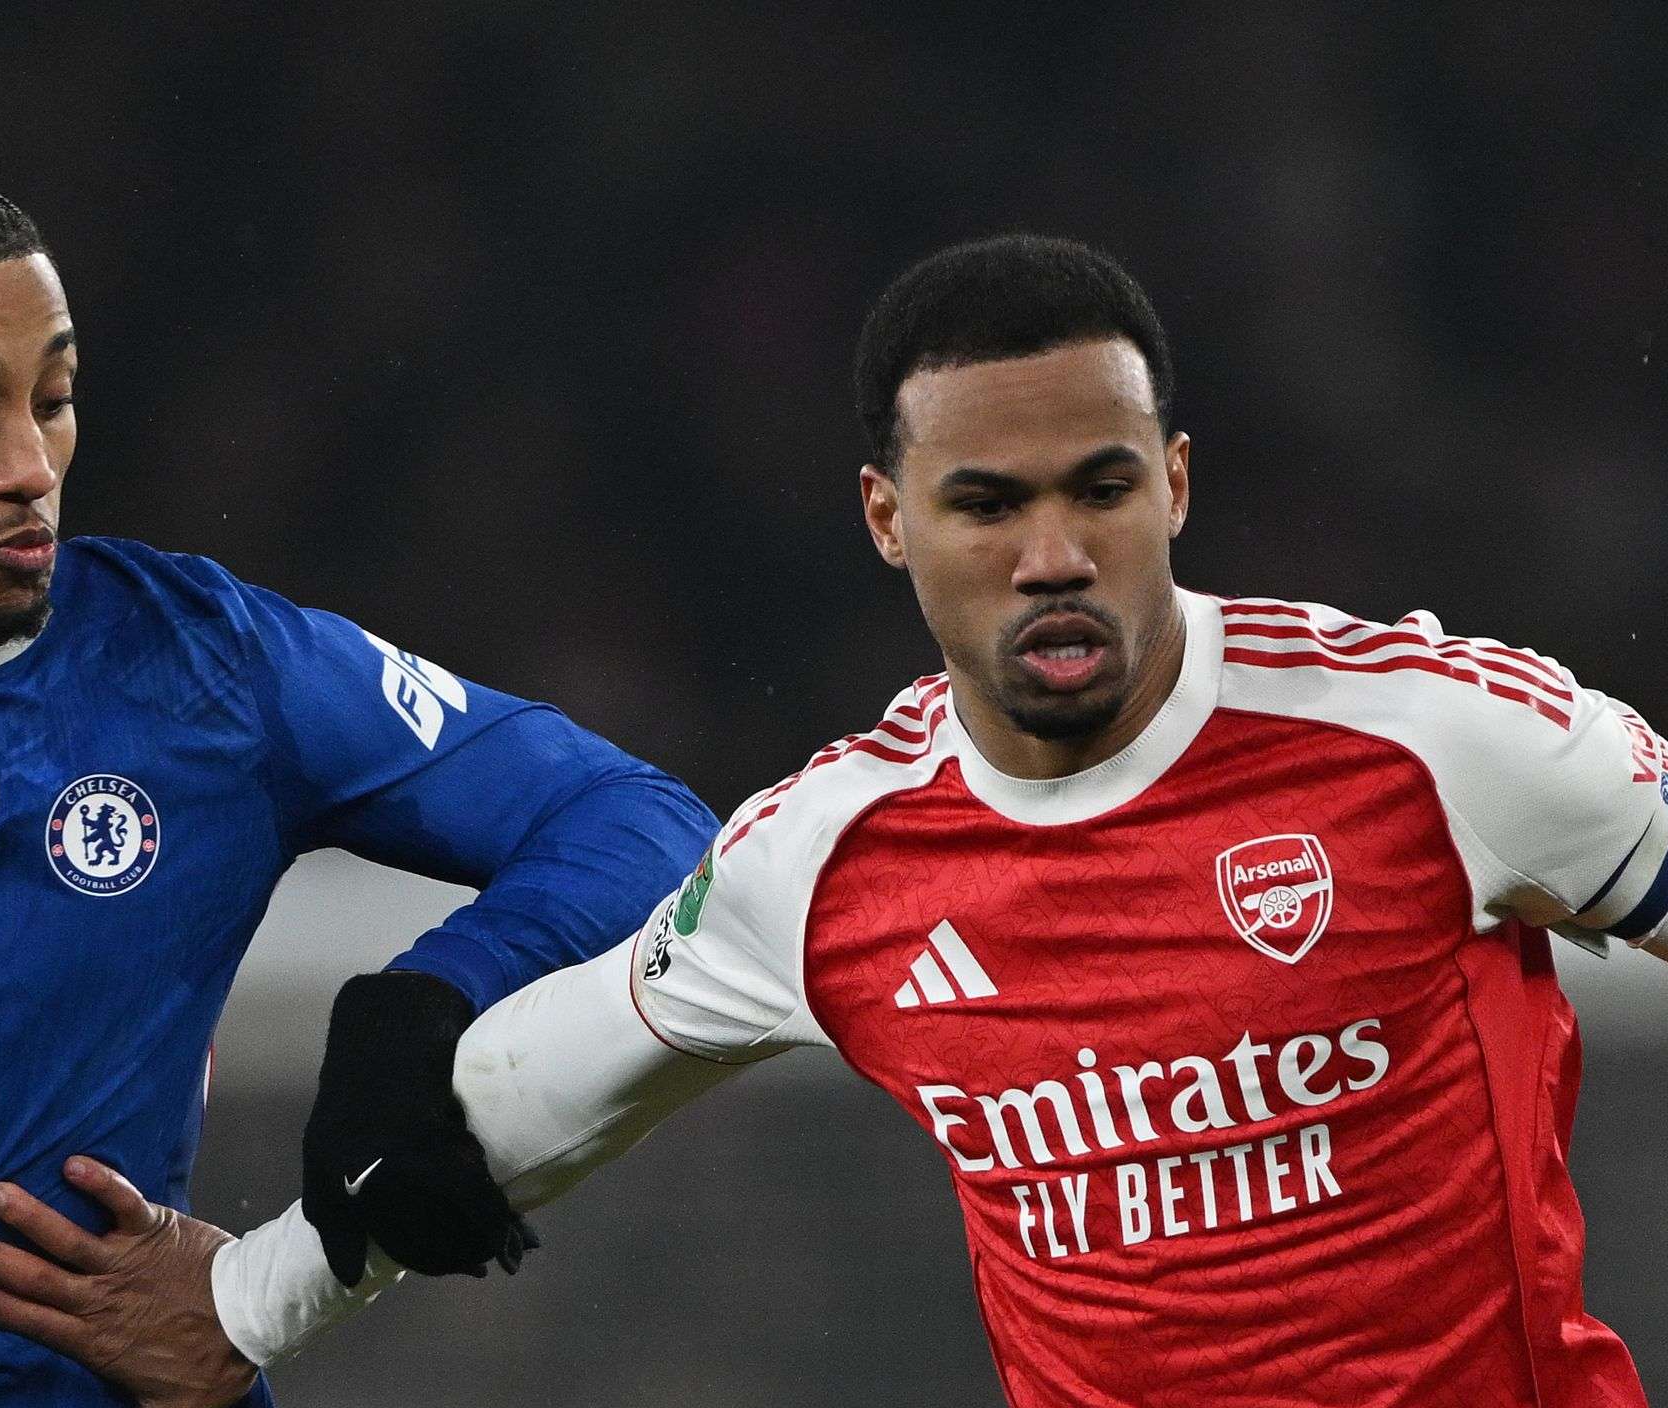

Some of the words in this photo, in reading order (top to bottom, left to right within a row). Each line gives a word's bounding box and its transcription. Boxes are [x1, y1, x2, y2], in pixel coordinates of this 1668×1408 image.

[64, 779, 138, 805] CHELSEA
[66, 870, 116, 889] FOOTBALL
[120, 865, 142, 885] CLUB
[1233, 851, 1313, 886] Arsenal
[916, 1018, 1390, 1172] Emirates
[1012, 1173, 1089, 1258] FLY
[1116, 1123, 1343, 1246] BETTER
